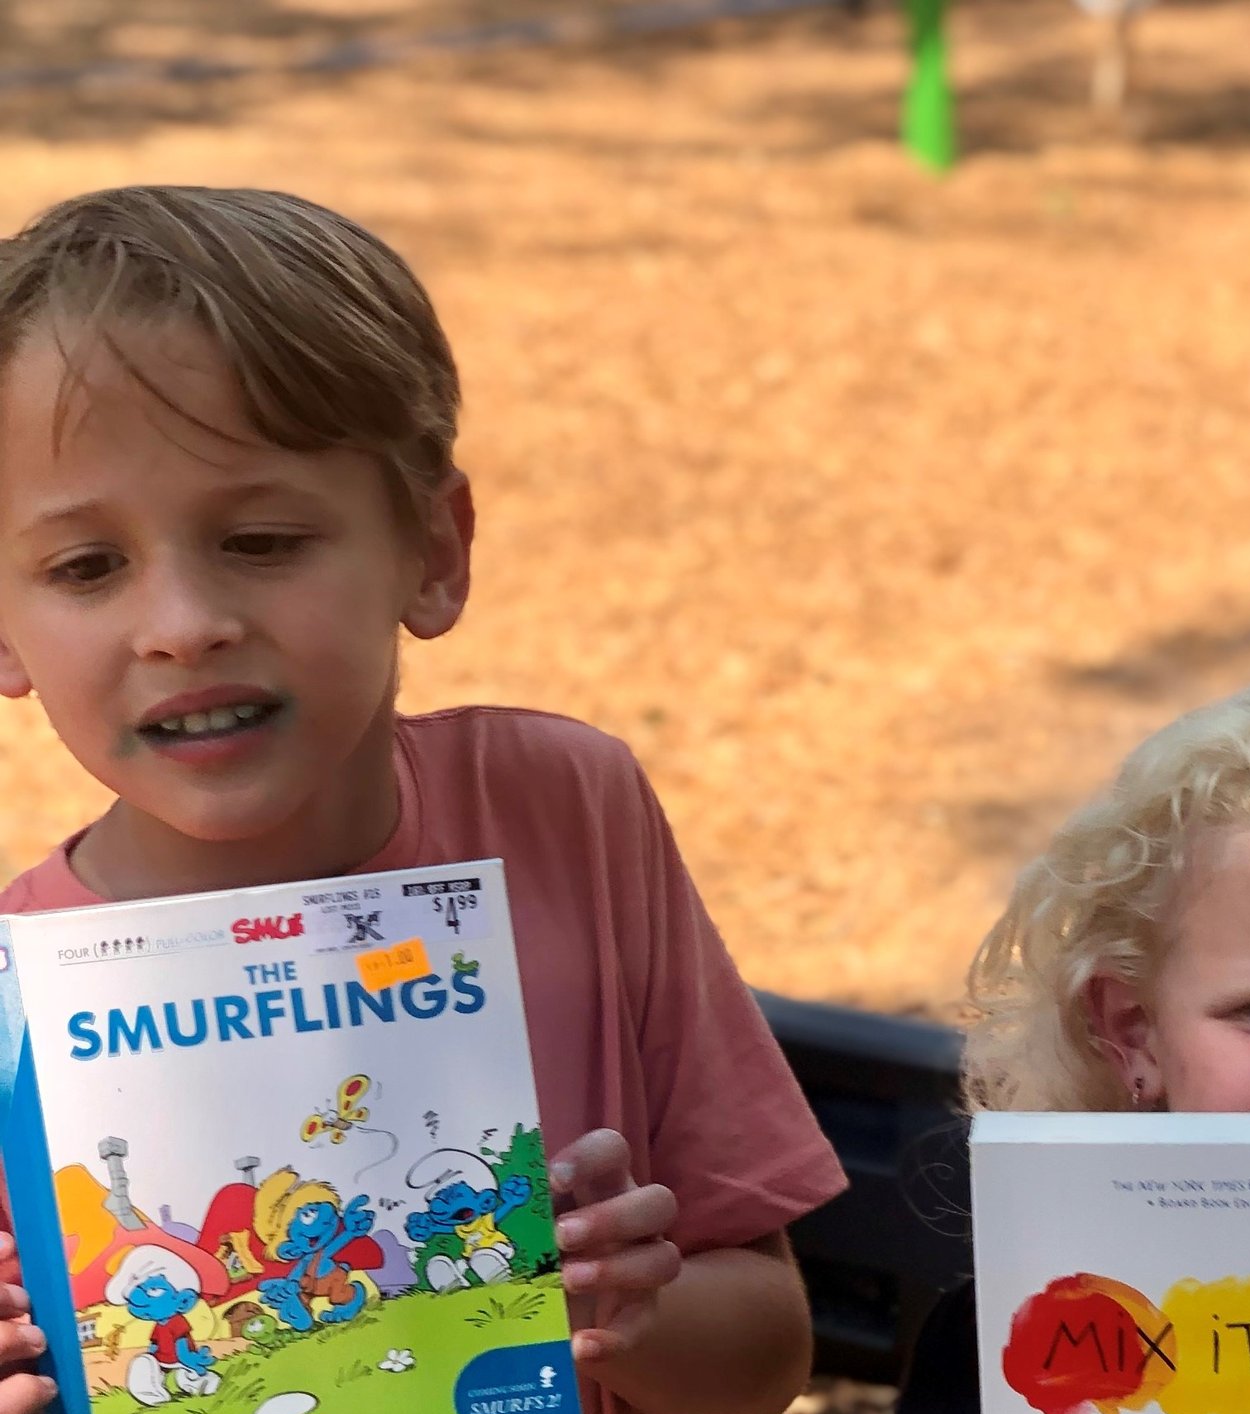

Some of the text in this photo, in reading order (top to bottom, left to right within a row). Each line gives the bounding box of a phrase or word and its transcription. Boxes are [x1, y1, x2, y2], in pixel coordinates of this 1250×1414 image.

[58, 948, 90, 960] FOUR
[244, 961, 298, 985] THE
[68, 970, 486, 1061] SMURFLINGS
